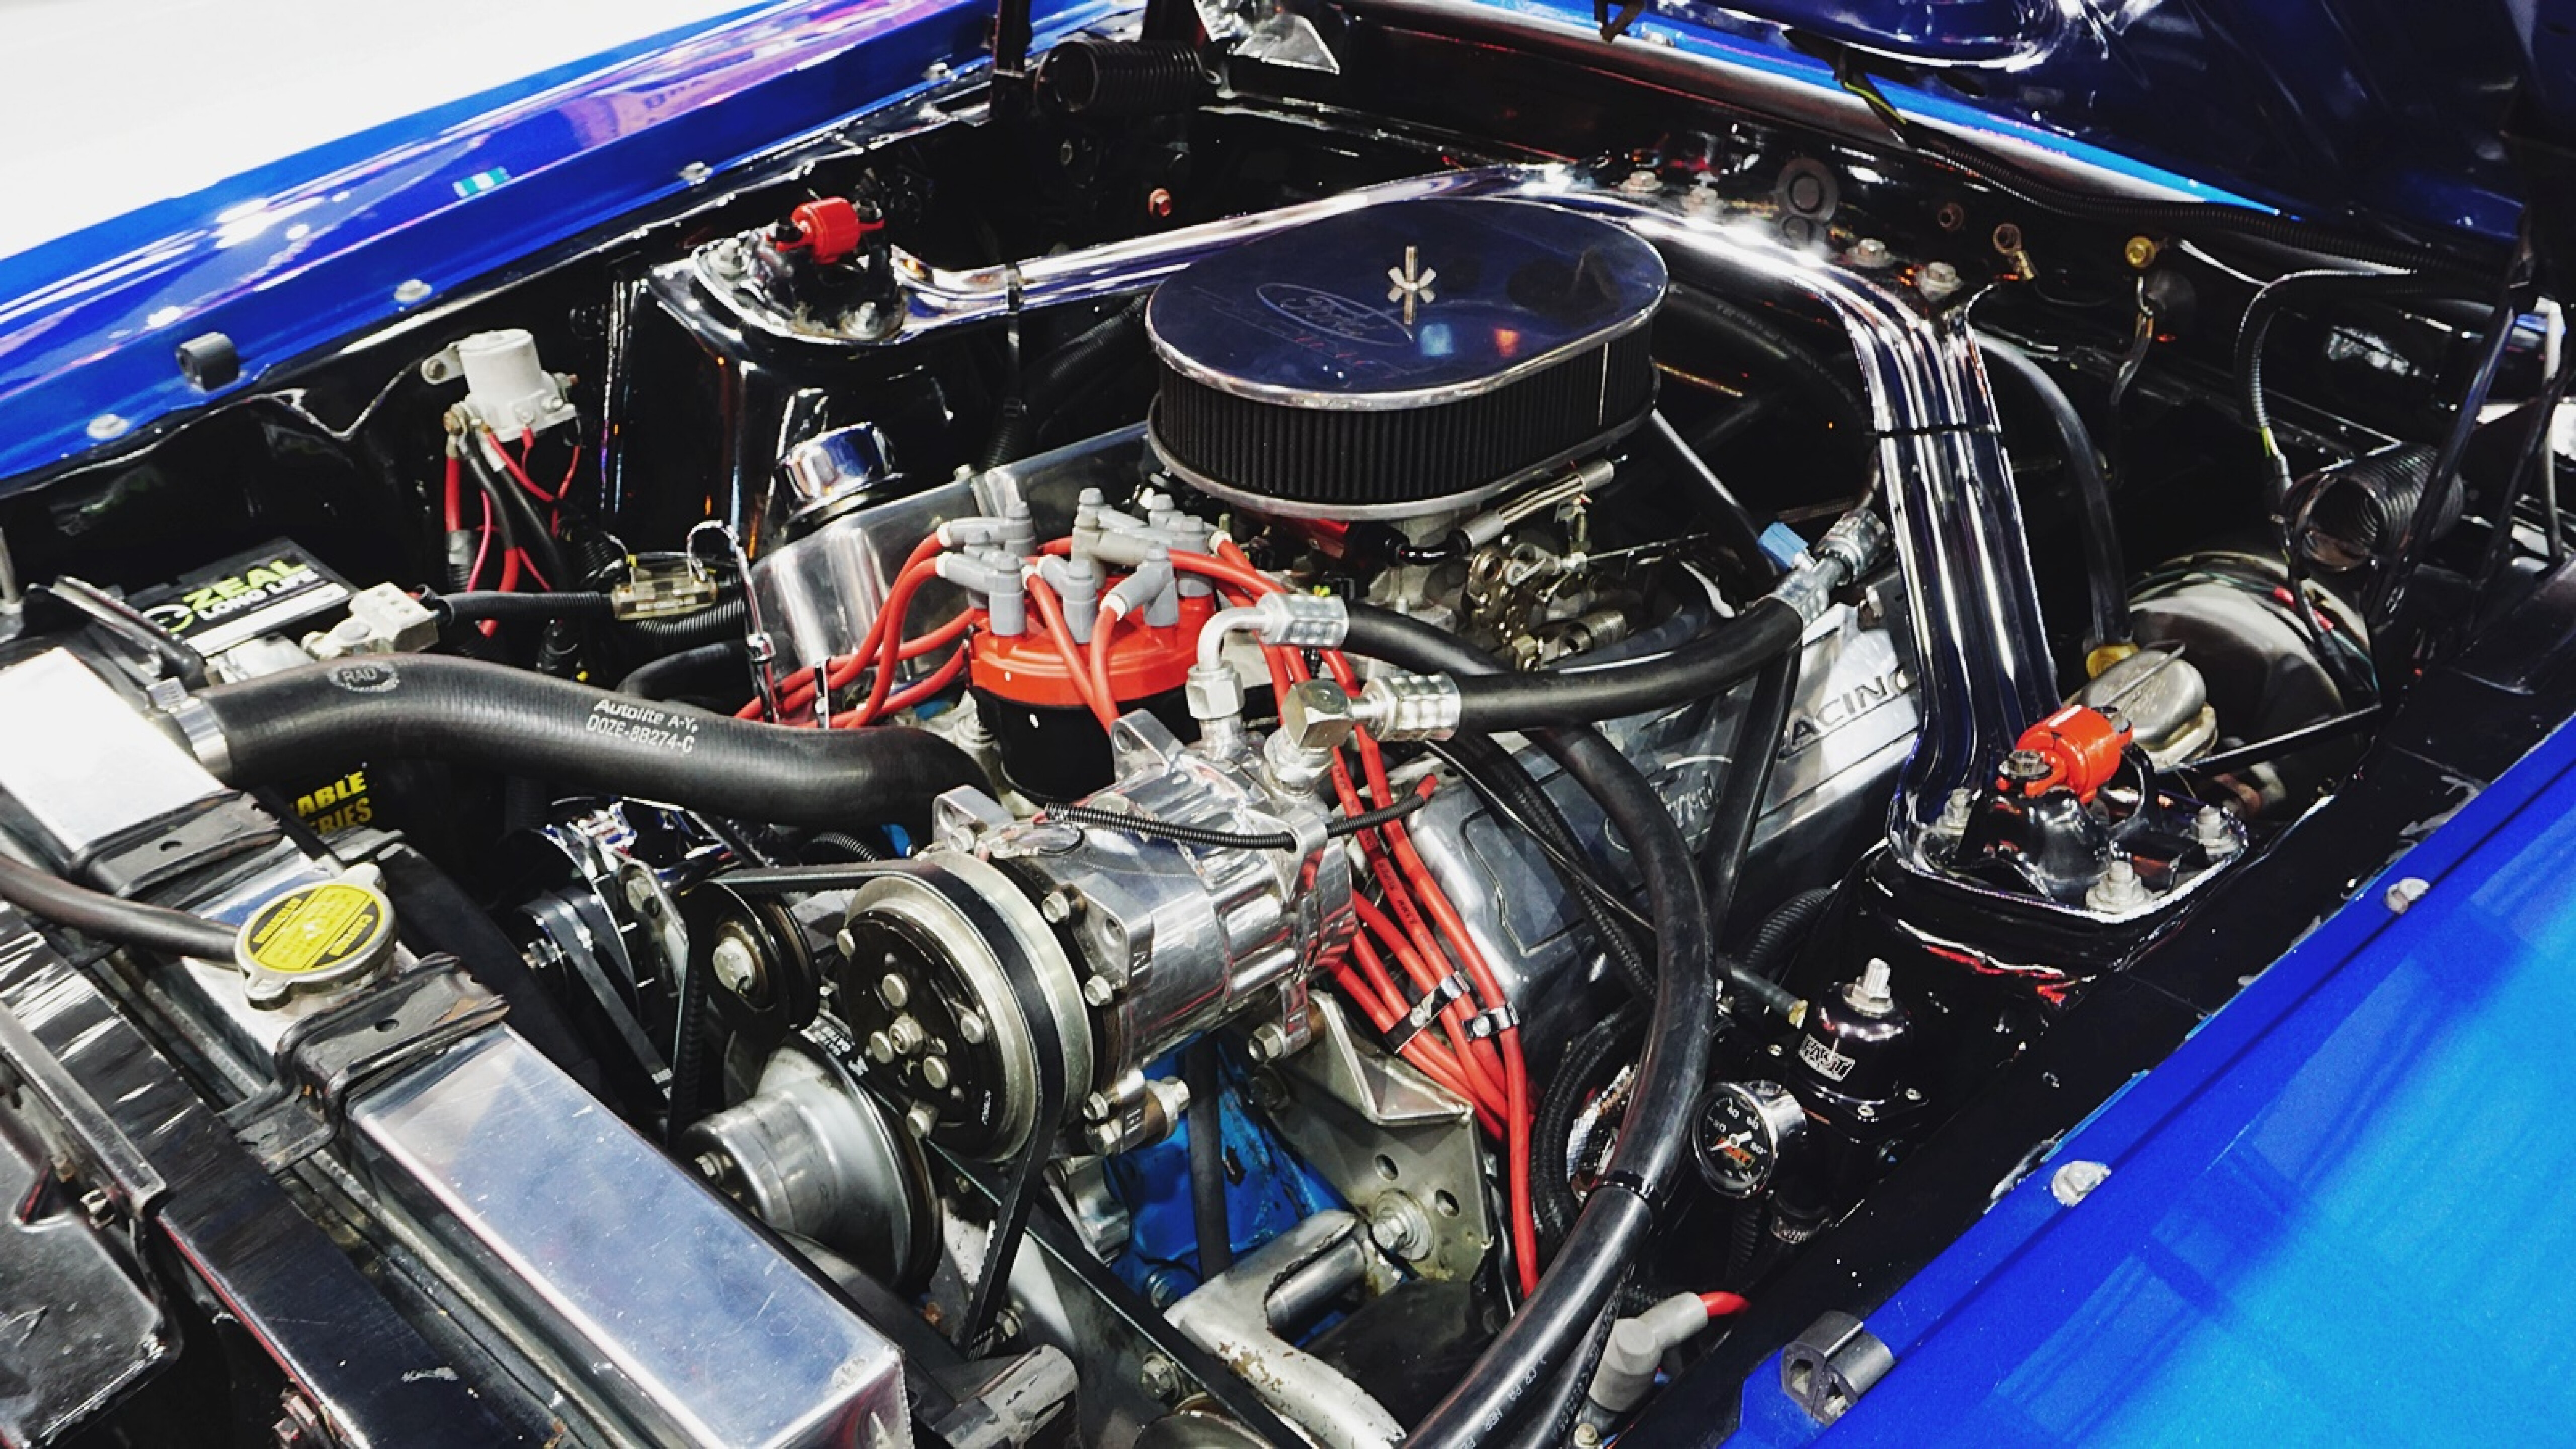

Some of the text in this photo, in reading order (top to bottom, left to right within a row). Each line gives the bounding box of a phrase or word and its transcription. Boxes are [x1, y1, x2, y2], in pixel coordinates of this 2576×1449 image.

[182, 560, 308, 611] ZEAL
[295, 770, 368, 817] ABLE
[309, 797, 372, 835] RIES
